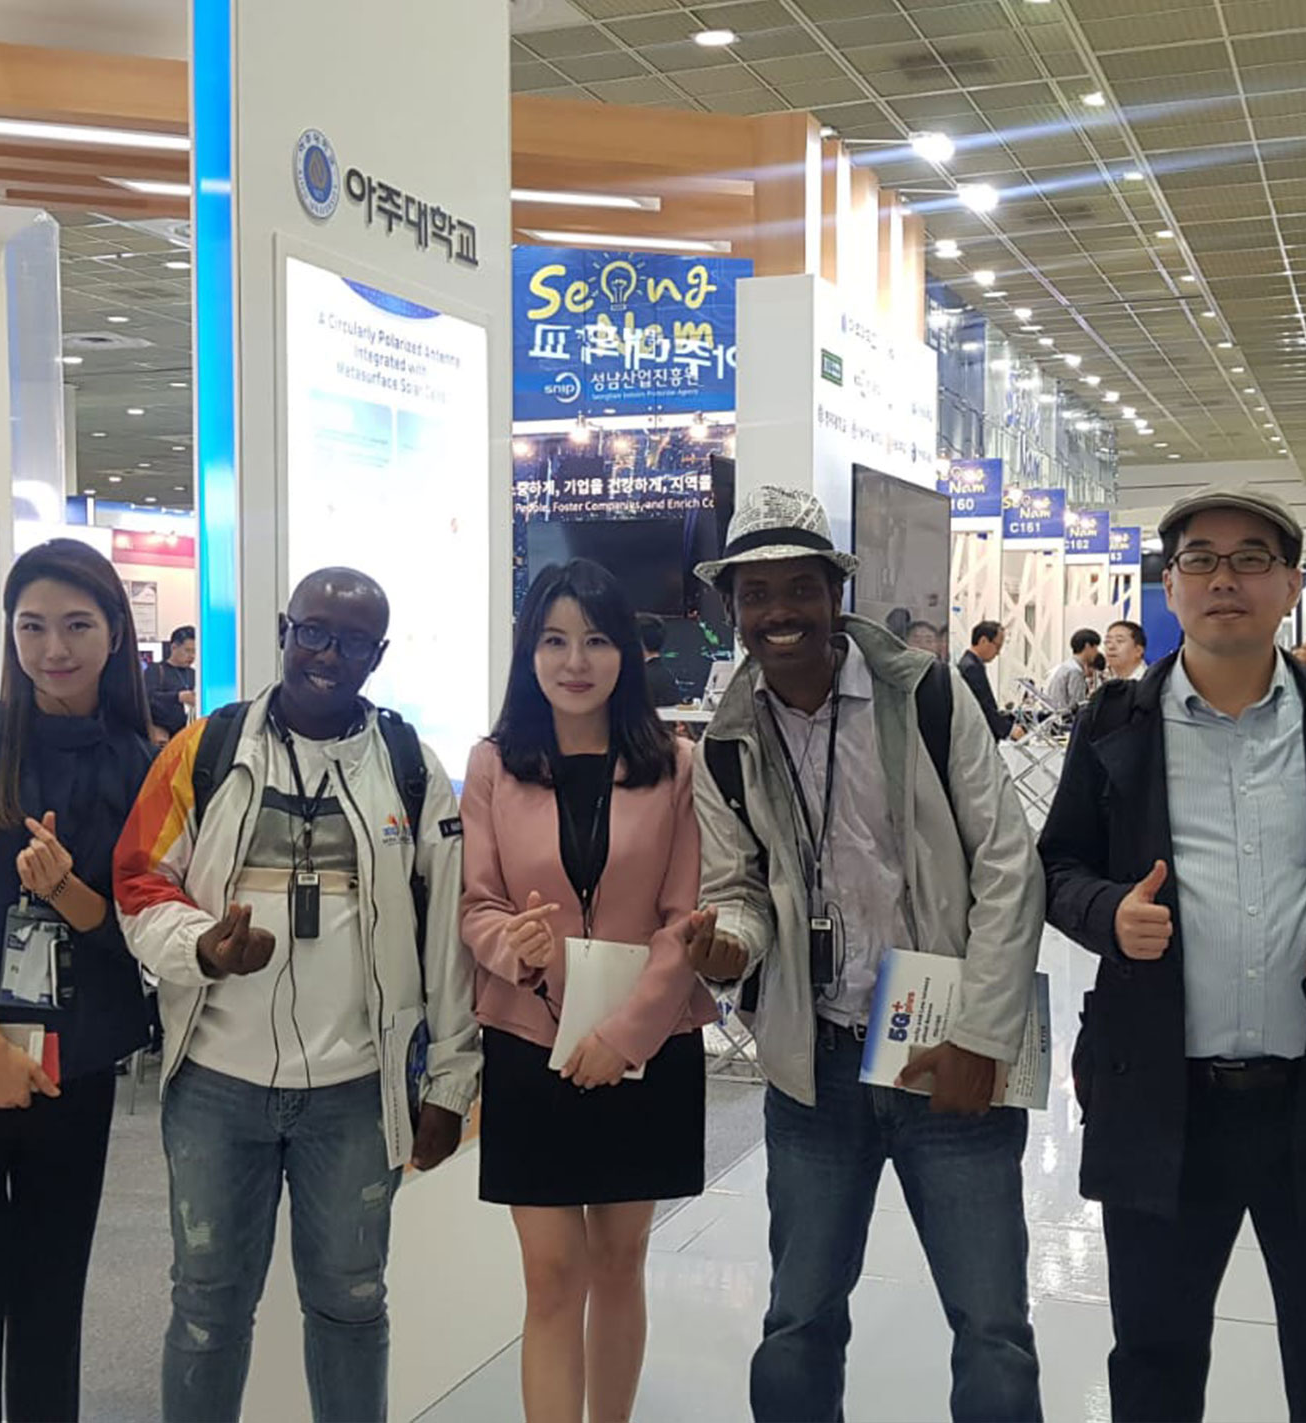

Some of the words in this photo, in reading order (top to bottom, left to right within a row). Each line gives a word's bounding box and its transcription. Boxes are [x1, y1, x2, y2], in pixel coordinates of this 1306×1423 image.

[346, 167, 479, 267] 아주대학교
[590, 367, 700, 392] 성남산업진흥원
[564, 479, 603, 496] 기업을
[552, 501, 583, 513] Foster
[667, 496, 700, 510] Enrich
